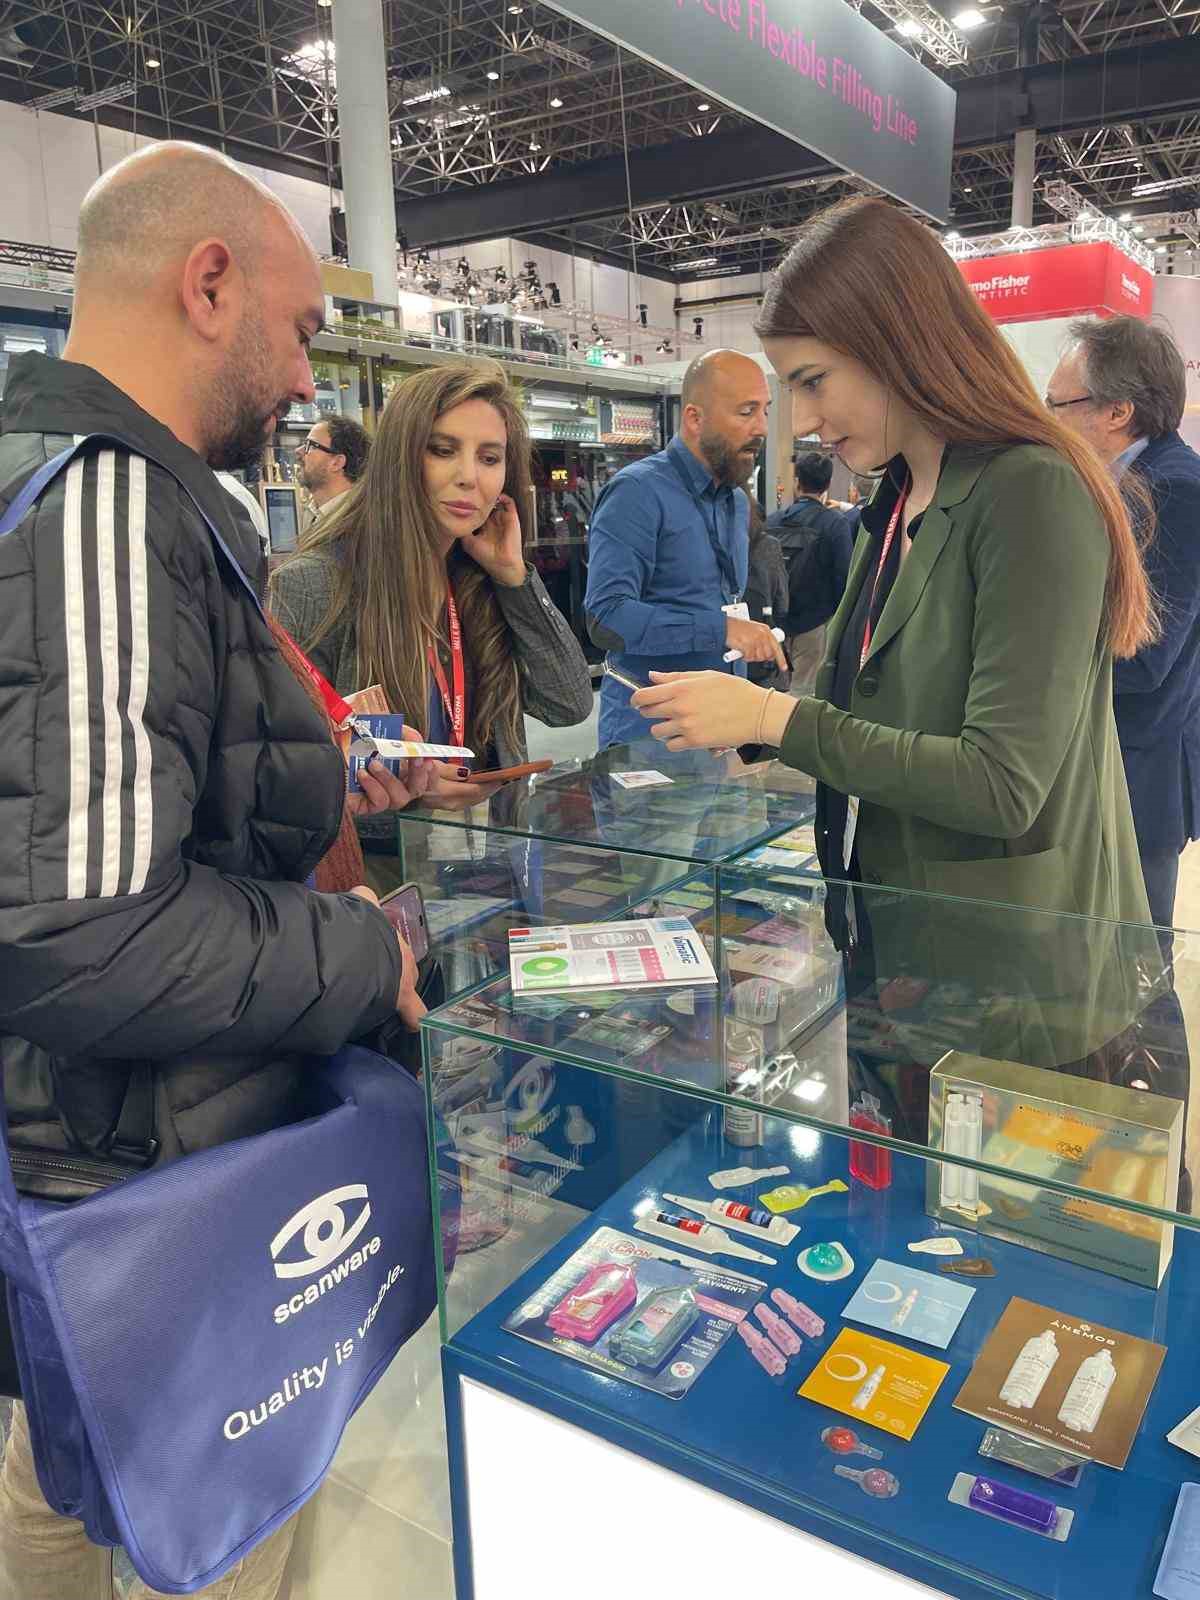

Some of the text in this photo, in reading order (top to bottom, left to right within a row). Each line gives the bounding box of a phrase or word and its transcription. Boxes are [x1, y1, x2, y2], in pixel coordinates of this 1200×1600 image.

[748, 0, 828, 89] Flexible
[832, 57, 883, 134] Filling
[887, 95, 919, 145] Line
[974, 287, 1028, 301] NTIFIC
[992, 275, 1031, 290] Fisher
[274, 1236, 381, 1325] scanware
[223, 1356, 329, 1441] Quality
[334, 1338, 355, 1366] is
